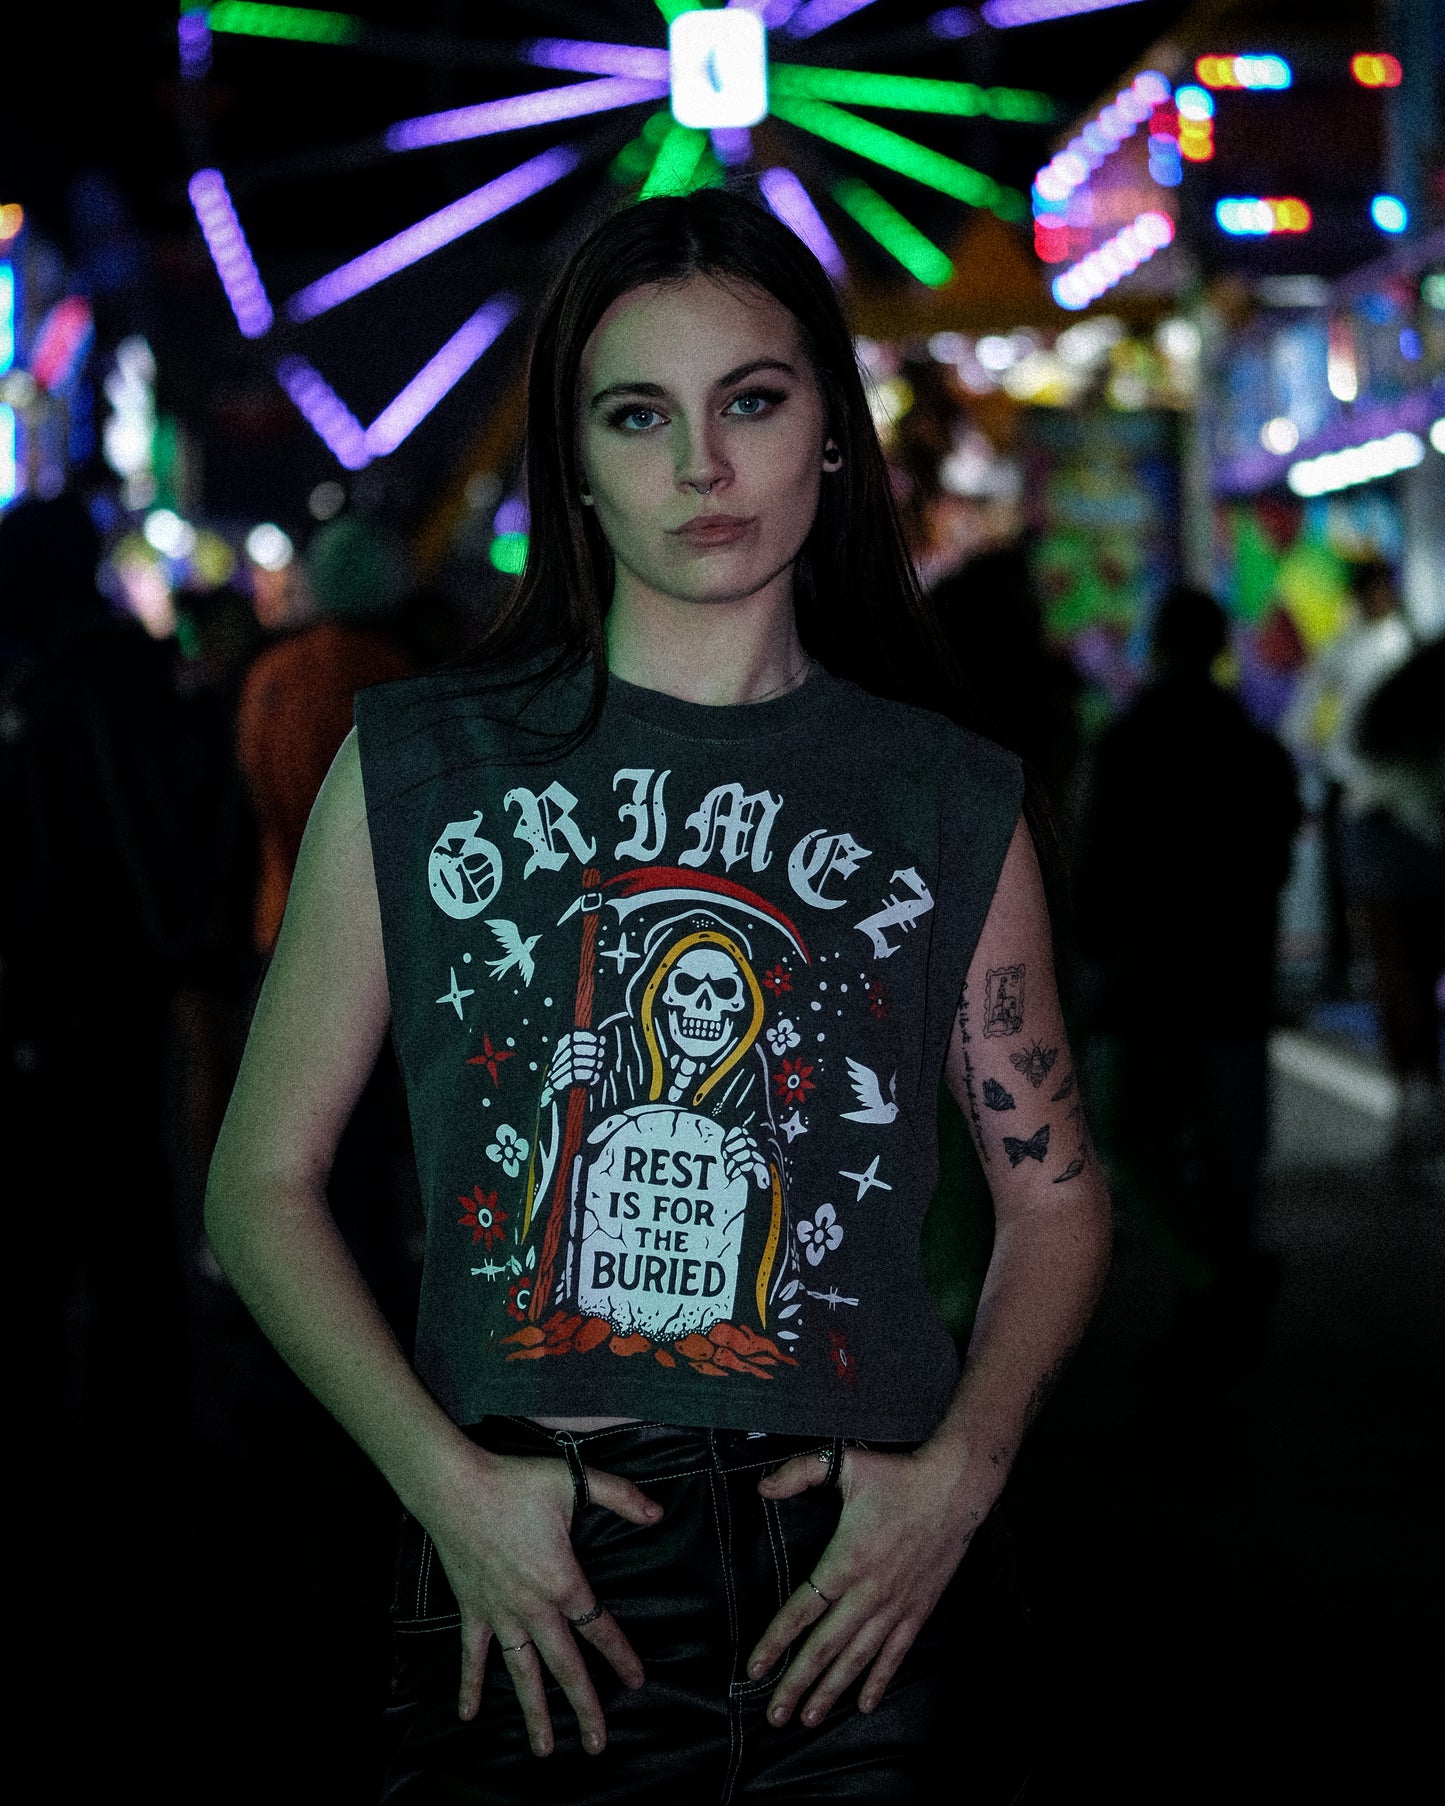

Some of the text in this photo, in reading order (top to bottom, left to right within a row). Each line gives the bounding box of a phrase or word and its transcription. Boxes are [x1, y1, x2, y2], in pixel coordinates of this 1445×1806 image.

[428, 768, 935, 960] GRIMEZ
[622, 1146, 717, 1190] REST
[609, 1191, 715, 1227] IS FOR
[635, 1227, 689, 1253] THE
[591, 1251, 726, 1298] BURIED
